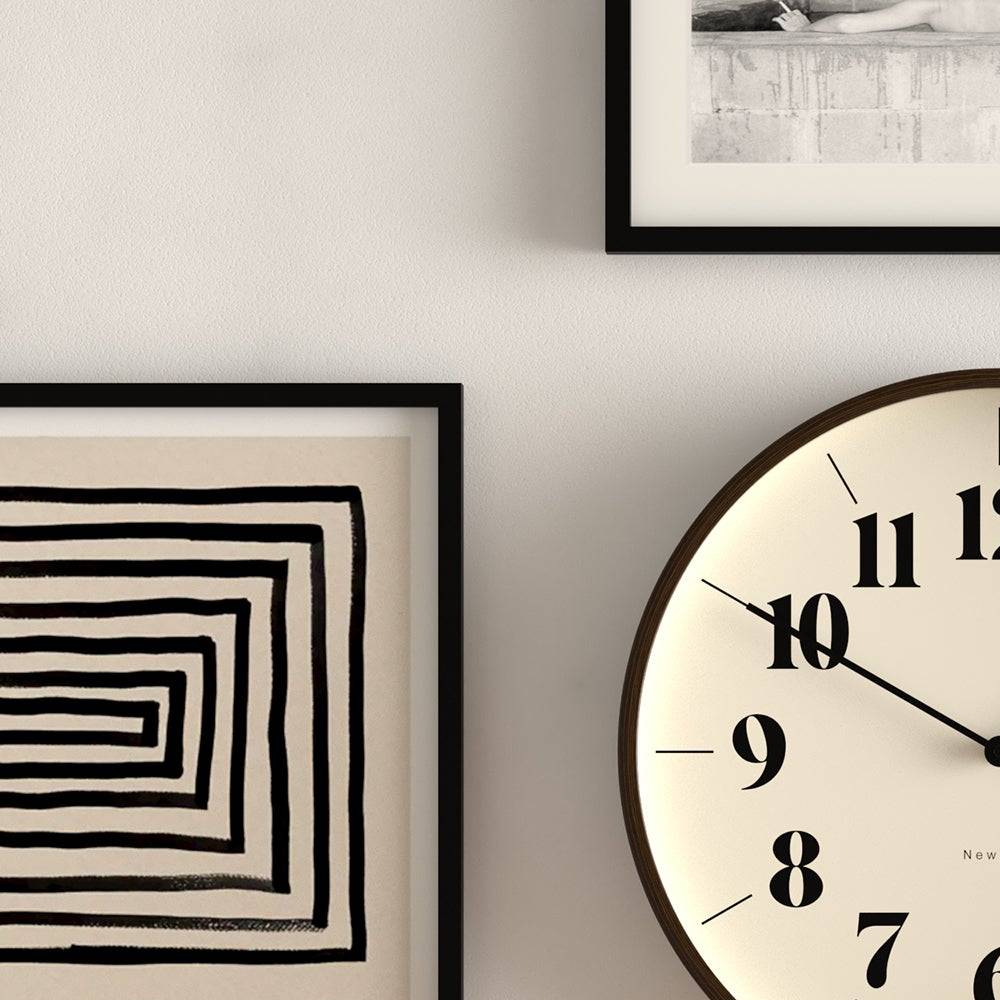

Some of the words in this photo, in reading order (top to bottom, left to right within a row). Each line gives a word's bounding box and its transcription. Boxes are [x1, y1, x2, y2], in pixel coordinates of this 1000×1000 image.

[851, 511, 921, 588] 11
[766, 592, 849, 670] 10
[731, 713, 787, 791] 9
[768, 830, 824, 908] 8
[856, 911, 910, 989] 7
